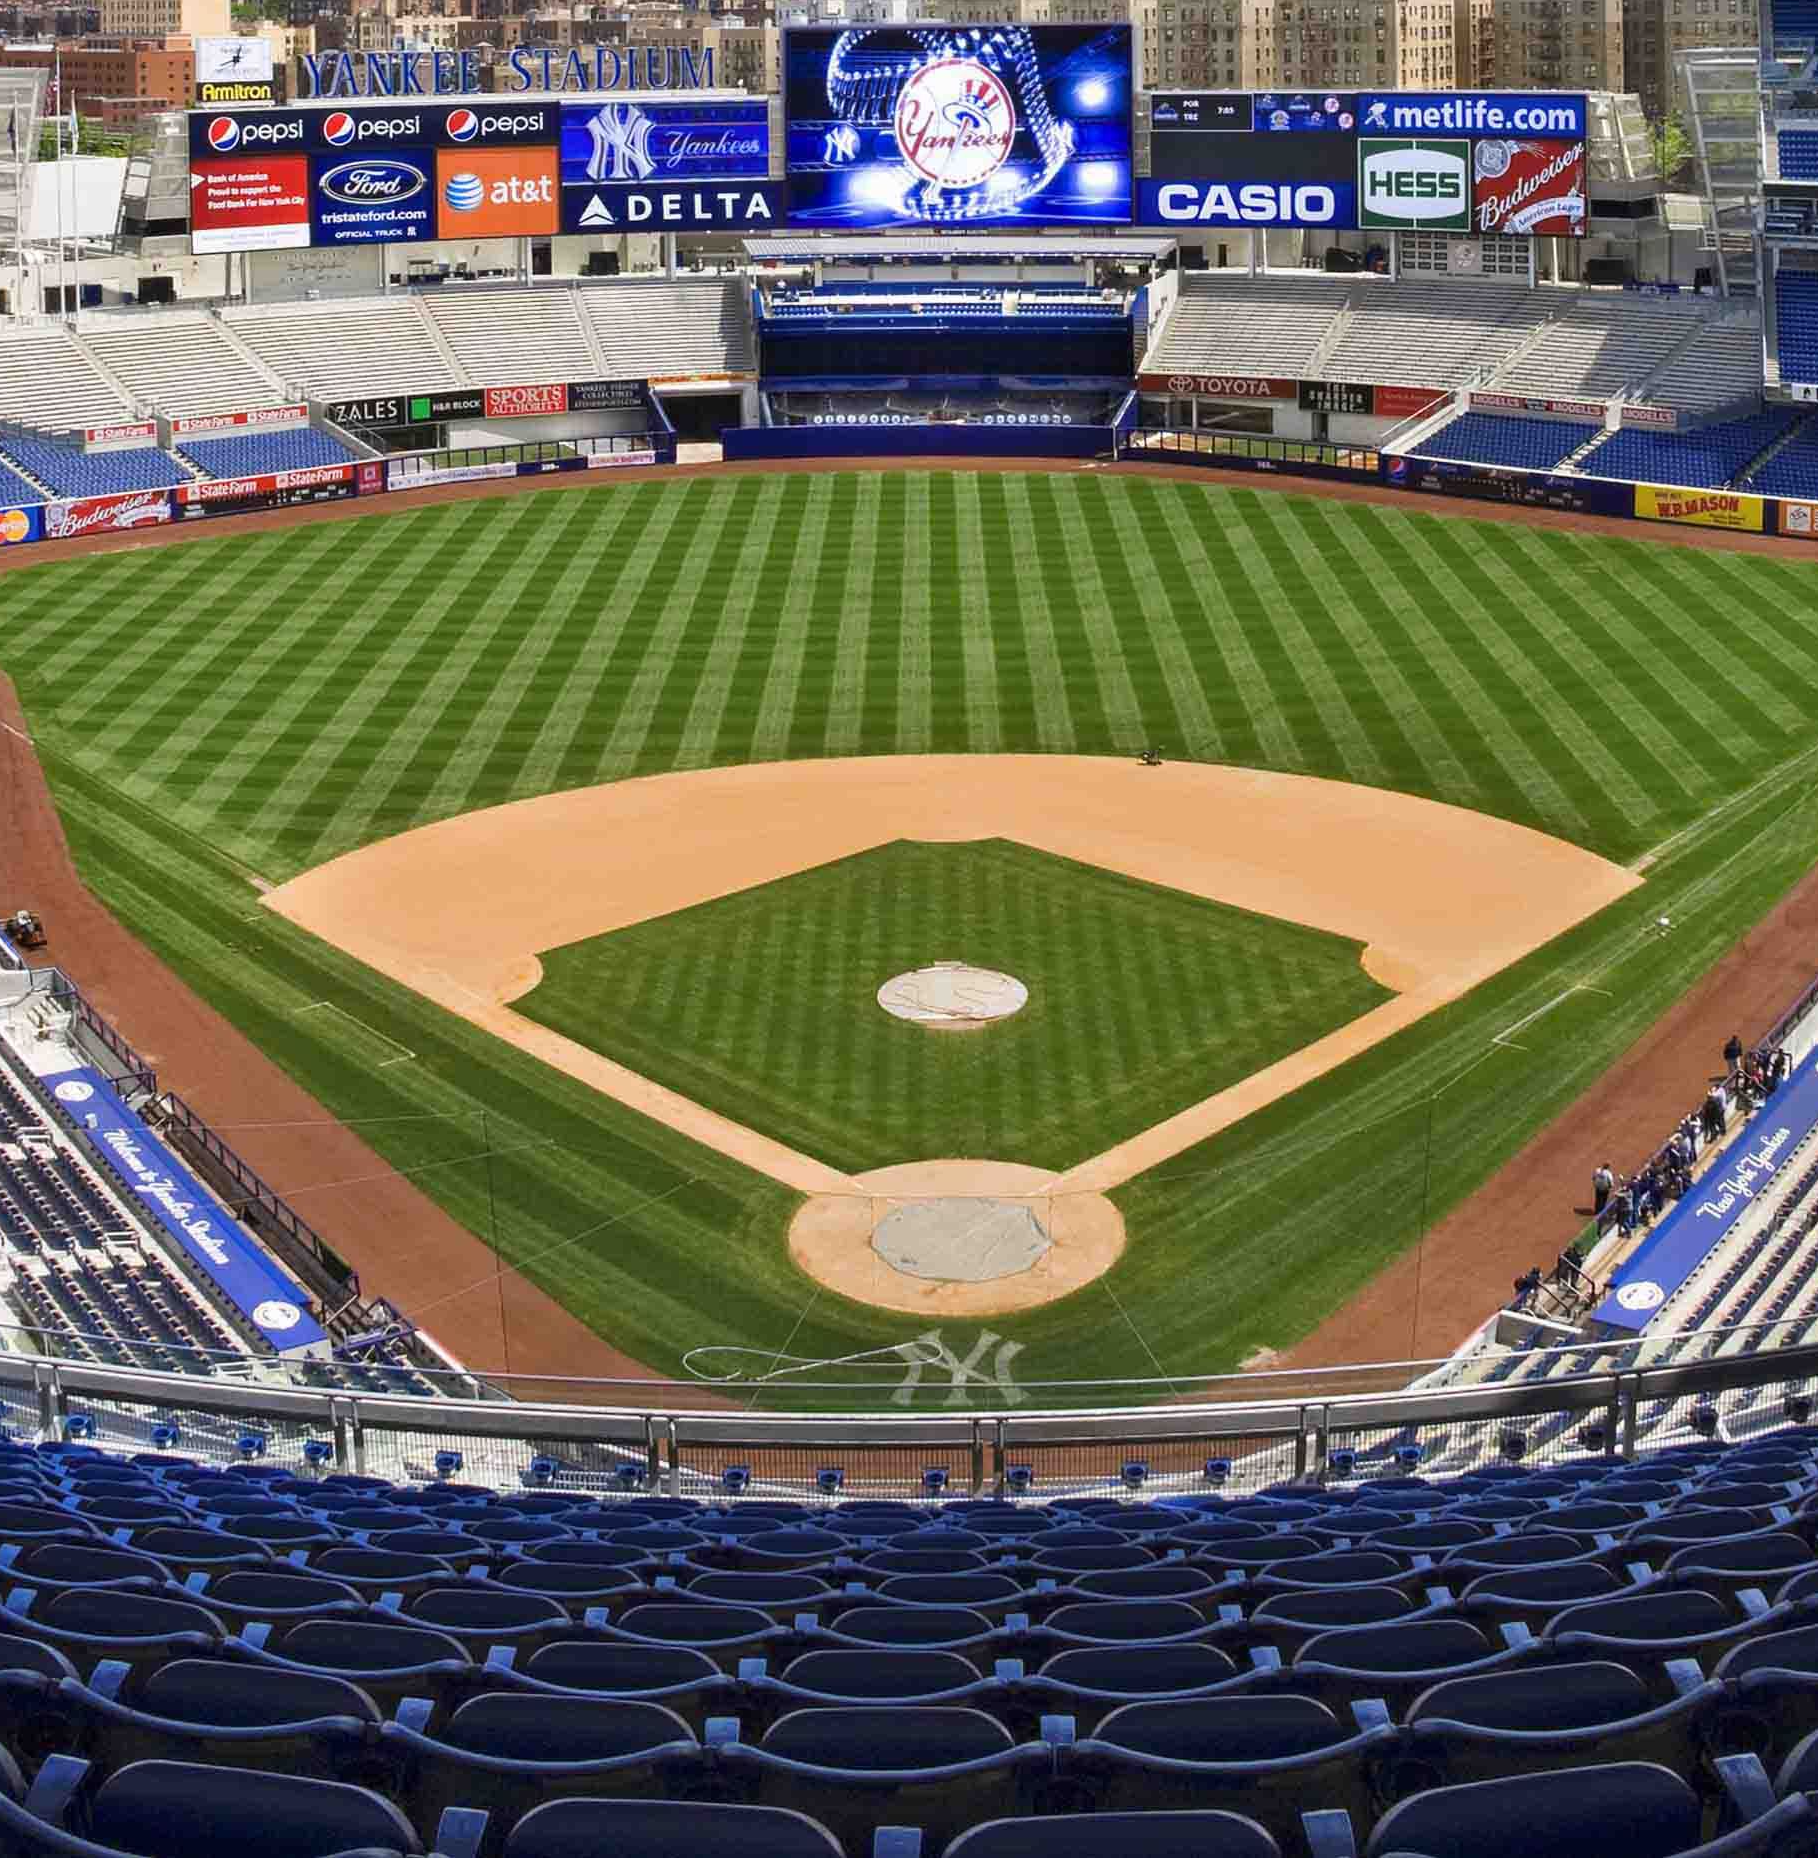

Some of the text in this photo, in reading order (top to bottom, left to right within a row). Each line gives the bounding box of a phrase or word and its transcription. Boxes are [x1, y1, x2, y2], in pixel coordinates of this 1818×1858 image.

[300, 46, 717, 99] YANKEE STADIUM
[202, 83, 272, 102] Armitron
[358, 115, 421, 140] pepsi
[481, 111, 544, 136] pepsi
[1393, 99, 1576, 131] metlife.com
[243, 119, 304, 145] pepsi
[585, 103, 657, 182] NY
[665, 129, 760, 168] Yankees
[207, 173, 268, 183] Bank of America
[344, 170, 401, 195] Ford
[490, 175, 552, 204] at&t
[1369, 171, 1460, 198] HESS
[1473, 142, 1586, 231] Budweiser
[207, 187, 230, 196] Proud
[1158, 184, 1335, 222] CASIO
[207, 200, 226, 209] Food
[321, 209, 427, 225] tristateford.com
[627, 193, 772, 221] DELTA
[335, 229, 373, 239] OFFICIAL
[374, 228, 403, 237] TRUCK
[489, 386, 562, 405] SPORTS
[1197, 377, 1271, 395] TOYOTA
[335, 399, 398, 423] ZALES
[452, 399, 481, 410] BLOCK
[58, 491, 153, 538] Budweiser
[1684, 496, 1740, 515] MASON
[1696, 1128, 1791, 1219] New York Yankees
[134, 1178, 194, 1220] Yankee
[180, 1220, 230, 1265] Stadium
